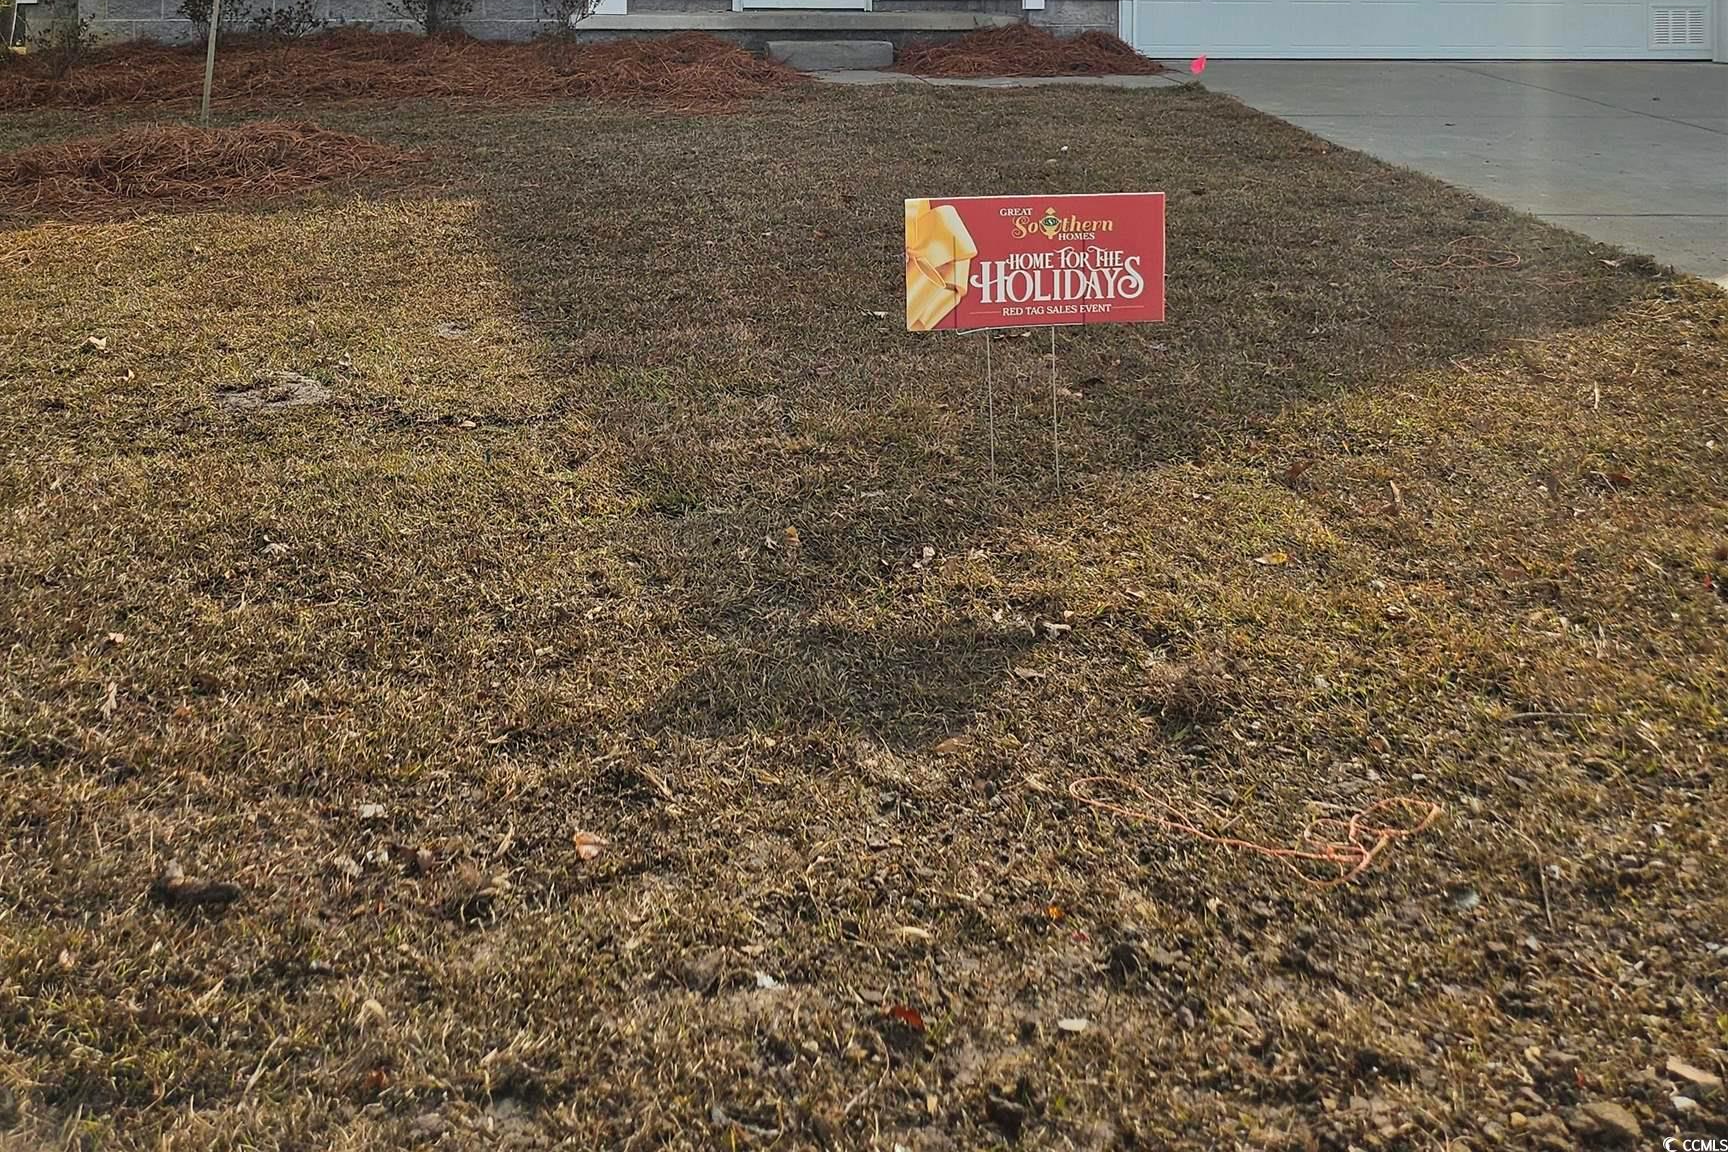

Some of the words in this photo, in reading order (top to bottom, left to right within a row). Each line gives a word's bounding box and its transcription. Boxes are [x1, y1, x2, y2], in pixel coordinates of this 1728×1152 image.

[999, 207, 1033, 217] GREAT
[1058, 232, 1096, 241] HOMES
[1006, 252, 1054, 271] HOME
[1055, 246, 1095, 271] FOR
[1087, 246, 1124, 268] THE
[970, 256, 1144, 304] HOLIDAYS
[1002, 307, 1023, 317] RED
[1025, 305, 1044, 315] TAG
[1046, 304, 1077, 314] SALES
[1079, 303, 1112, 313] EVENT
